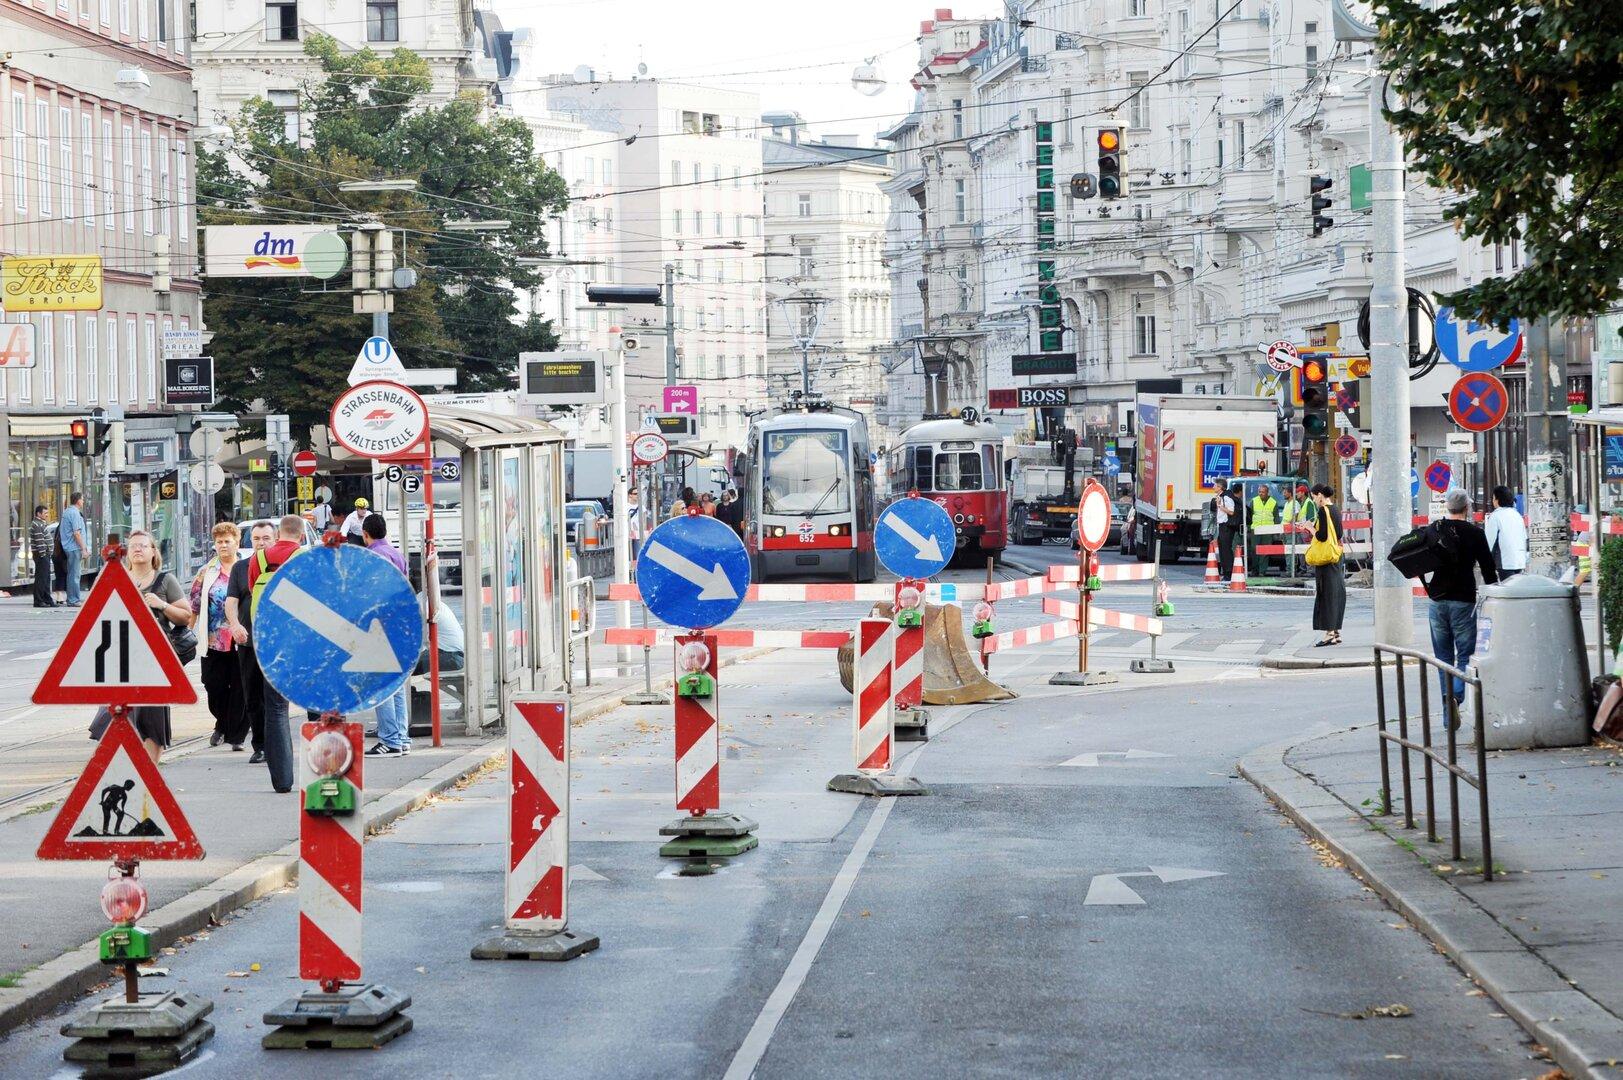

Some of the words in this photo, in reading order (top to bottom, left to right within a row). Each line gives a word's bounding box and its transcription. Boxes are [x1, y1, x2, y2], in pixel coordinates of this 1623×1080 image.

[254, 231, 294, 256] dm
[29, 296, 76, 305] BROT
[367, 341, 388, 363] U
[1021, 389, 1066, 403] BOSS
[341, 391, 416, 418] STRASSENBAHN
[963, 409, 975, 420] 37
[345, 427, 415, 451] HALTESTELLE
[389, 467, 399, 480] 5
[441, 466, 458, 477] 33
[406, 478, 416, 491] E
[799, 534, 815, 543] 652
